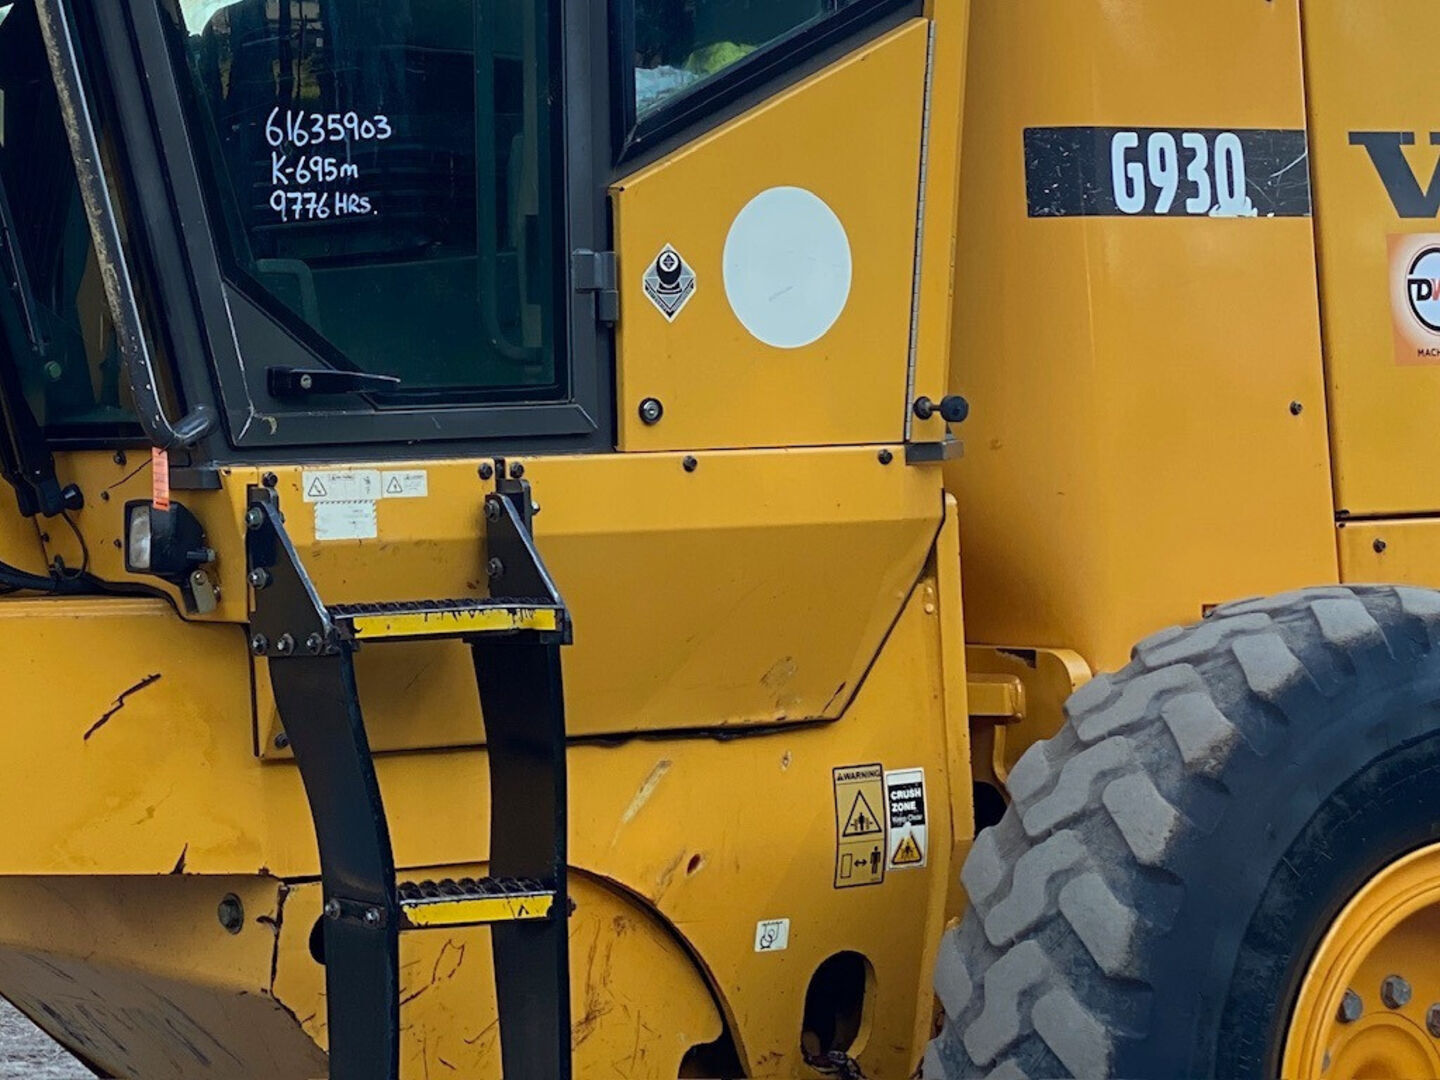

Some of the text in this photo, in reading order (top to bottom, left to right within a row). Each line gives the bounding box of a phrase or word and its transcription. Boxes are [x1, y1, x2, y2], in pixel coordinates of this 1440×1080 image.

[264, 106, 393, 148] 61635903
[1111, 131, 1250, 216] G930
[269, 189, 331, 223] 9776
[890, 787, 922, 801] CRUSH
[891, 800, 917, 813] ZONE
